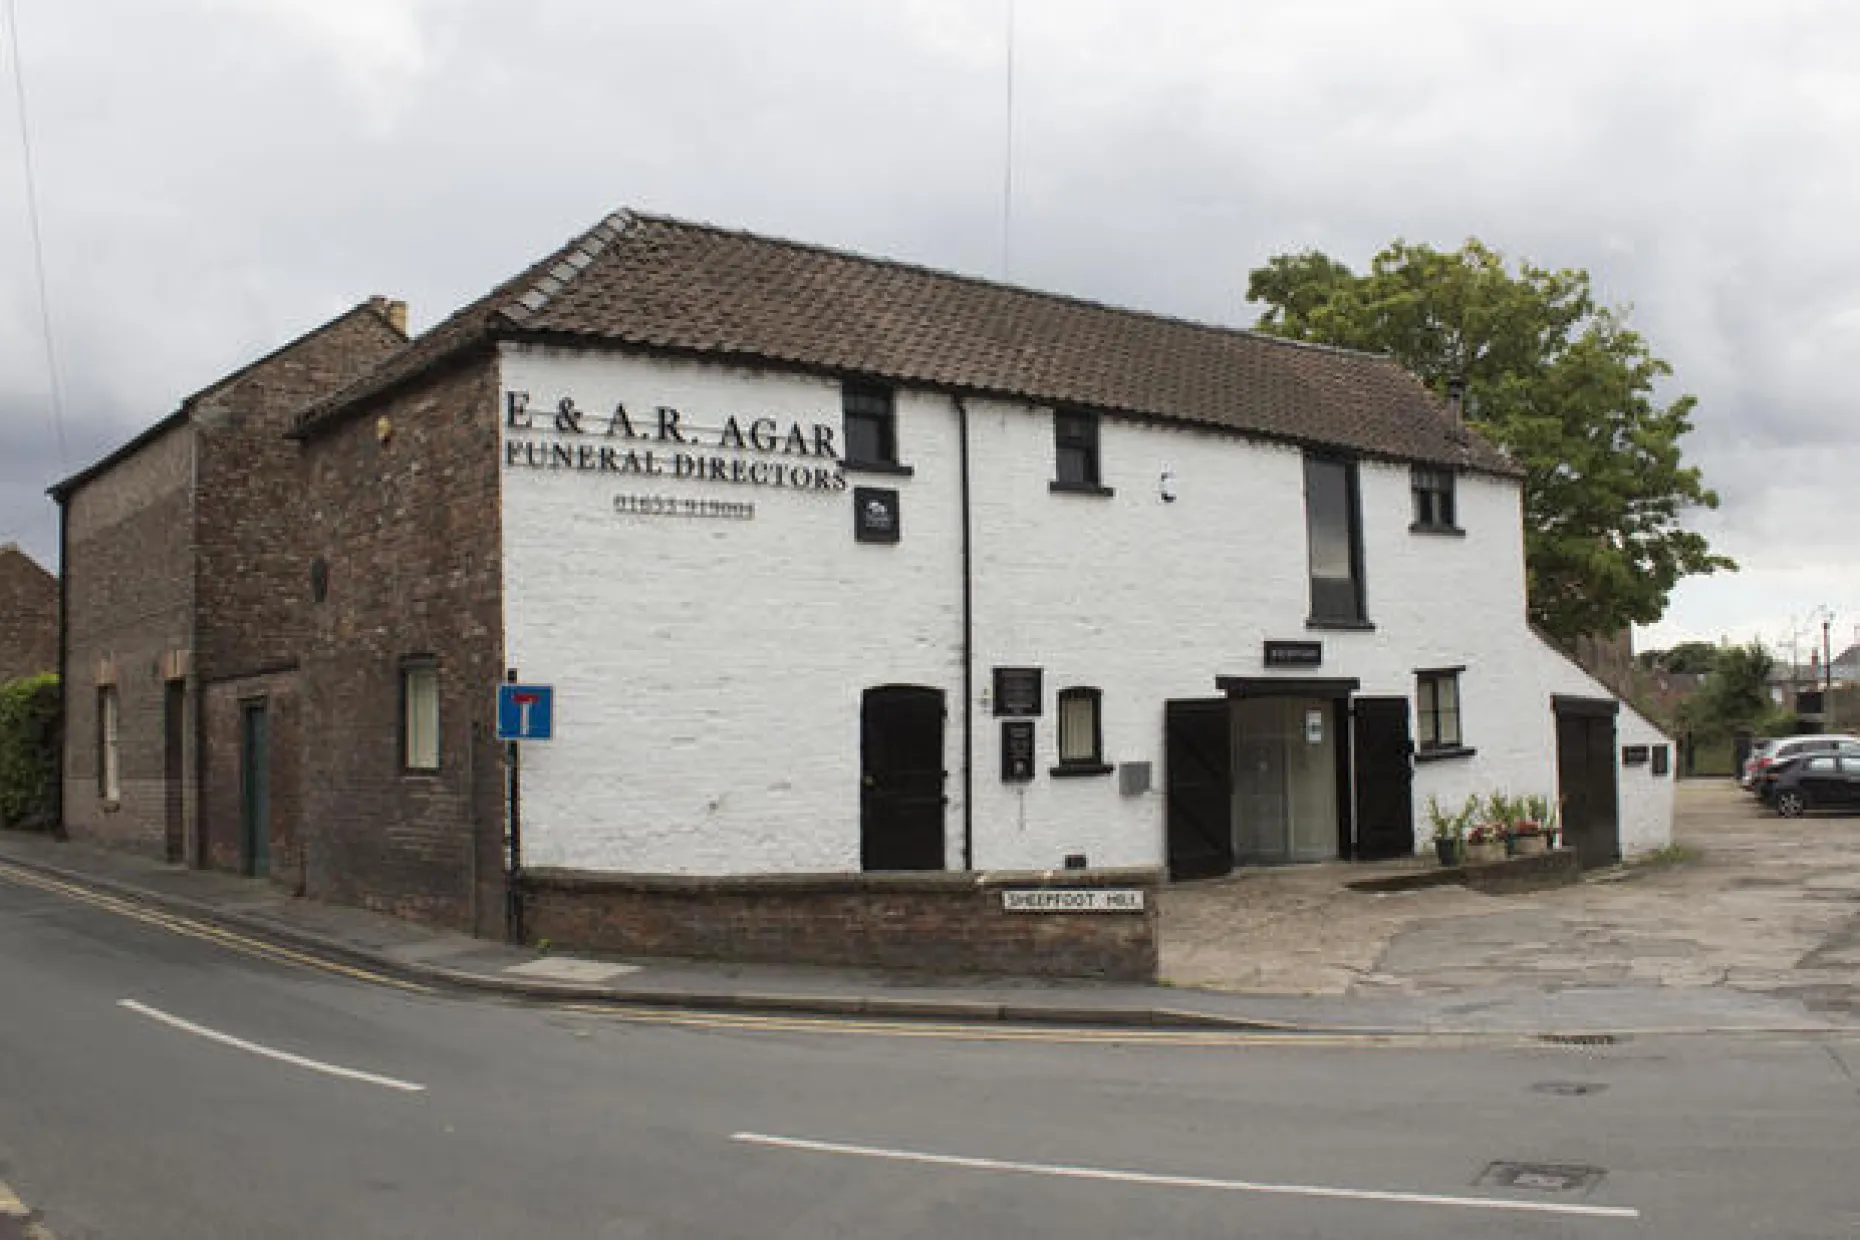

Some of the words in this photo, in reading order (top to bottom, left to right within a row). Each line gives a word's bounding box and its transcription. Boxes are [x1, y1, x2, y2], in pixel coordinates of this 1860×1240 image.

[506, 390, 532, 428] E
[555, 397, 584, 434] &
[718, 415, 839, 458] AGAR
[506, 438, 663, 476] FUNERAL
[674, 453, 848, 492] DIRECTORS
